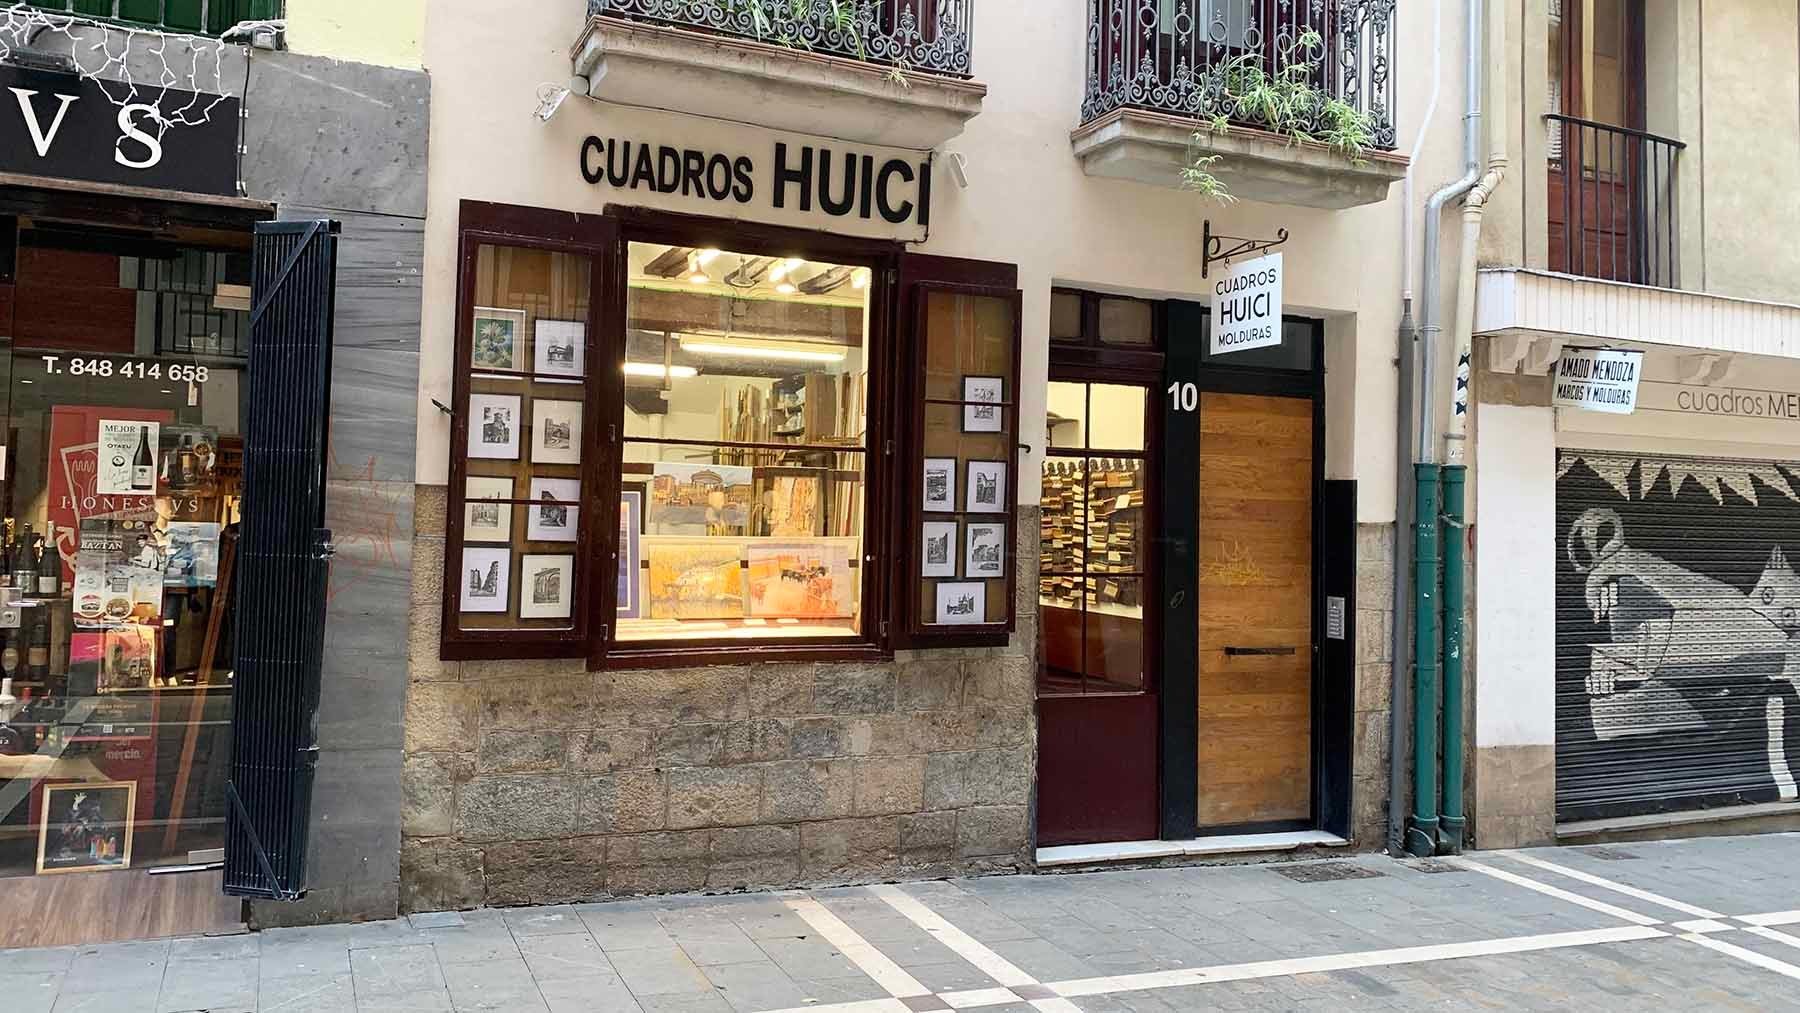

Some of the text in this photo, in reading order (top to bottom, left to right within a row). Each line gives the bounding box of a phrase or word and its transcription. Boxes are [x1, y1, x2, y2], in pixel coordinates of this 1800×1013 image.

[580, 135, 930, 226] CUADROS HUICI
[1215, 268, 1277, 296] CUADROS
[1220, 291, 1271, 326] HUICI
[1218, 325, 1272, 347] MOLDURAS
[42, 355, 209, 383] T. 848 414 658
[1560, 357, 1635, 382] AMADO MENDOZA
[1167, 381, 1198, 412] 10
[1556, 383, 1632, 406] MARCOS Y MOLDURAS
[1677, 387, 1800, 418] cuadros ME
[104, 424, 136, 433] MEJOR
